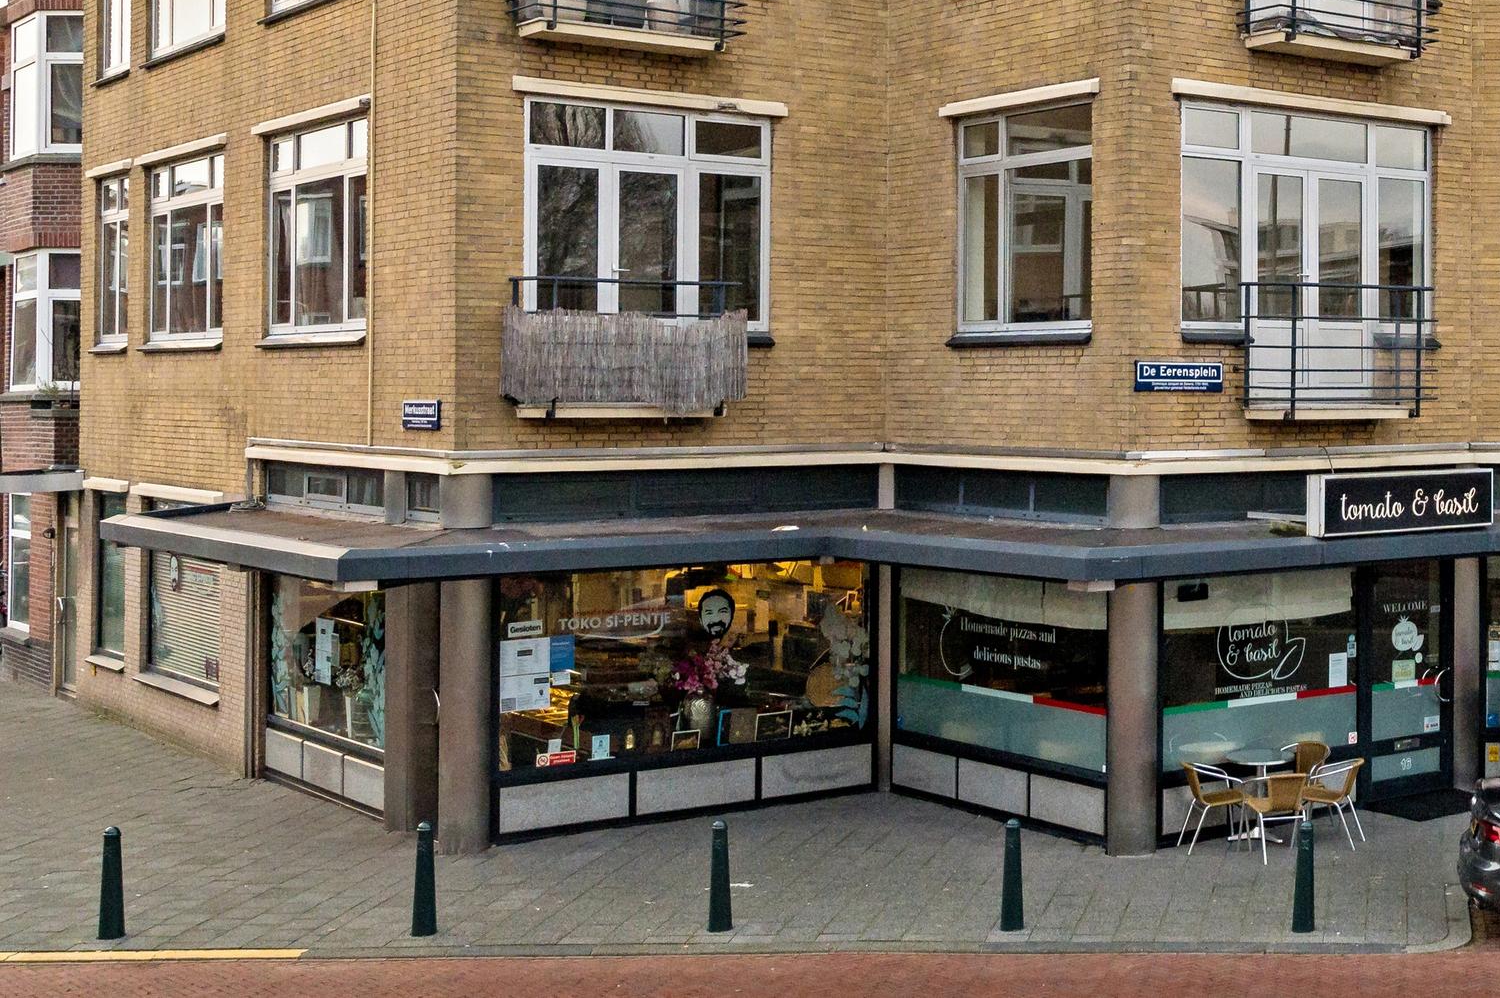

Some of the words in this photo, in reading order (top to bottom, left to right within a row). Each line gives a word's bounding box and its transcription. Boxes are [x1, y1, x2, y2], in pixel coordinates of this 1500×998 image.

[1143, 365, 1156, 376] De
[1160, 365, 1217, 378] Eerensplein
[1340, 491, 1405, 521] tomato
[1412, 488, 1429, 516] &
[1433, 487, 1479, 515] basil
[1383, 601, 1428, 613] WELCOME
[510, 625, 541, 635] Gesloten
[558, 617, 601, 631] TOKO
[606, 611, 671, 629] SI-PENTJE
[960, 617, 1008, 636] Homemade
[1009, 623, 1037, 641] pizzas
[1038, 628, 1056, 643] and
[1228, 621, 1277, 642] tomato
[973, 645, 1012, 664] delicious
[1014, 654, 1041, 670] pastas
[1226, 644, 1240, 666] &
[1244, 638, 1281, 662] basil
[1215, 683, 1251, 695] HOMEMADE
[1251, 681, 1273, 691] PIZZAS
[1240, 689, 1253, 698] AND
[1253, 687, 1285, 697] DELICIOUS
[1286, 684, 1308, 693] PASTAS
